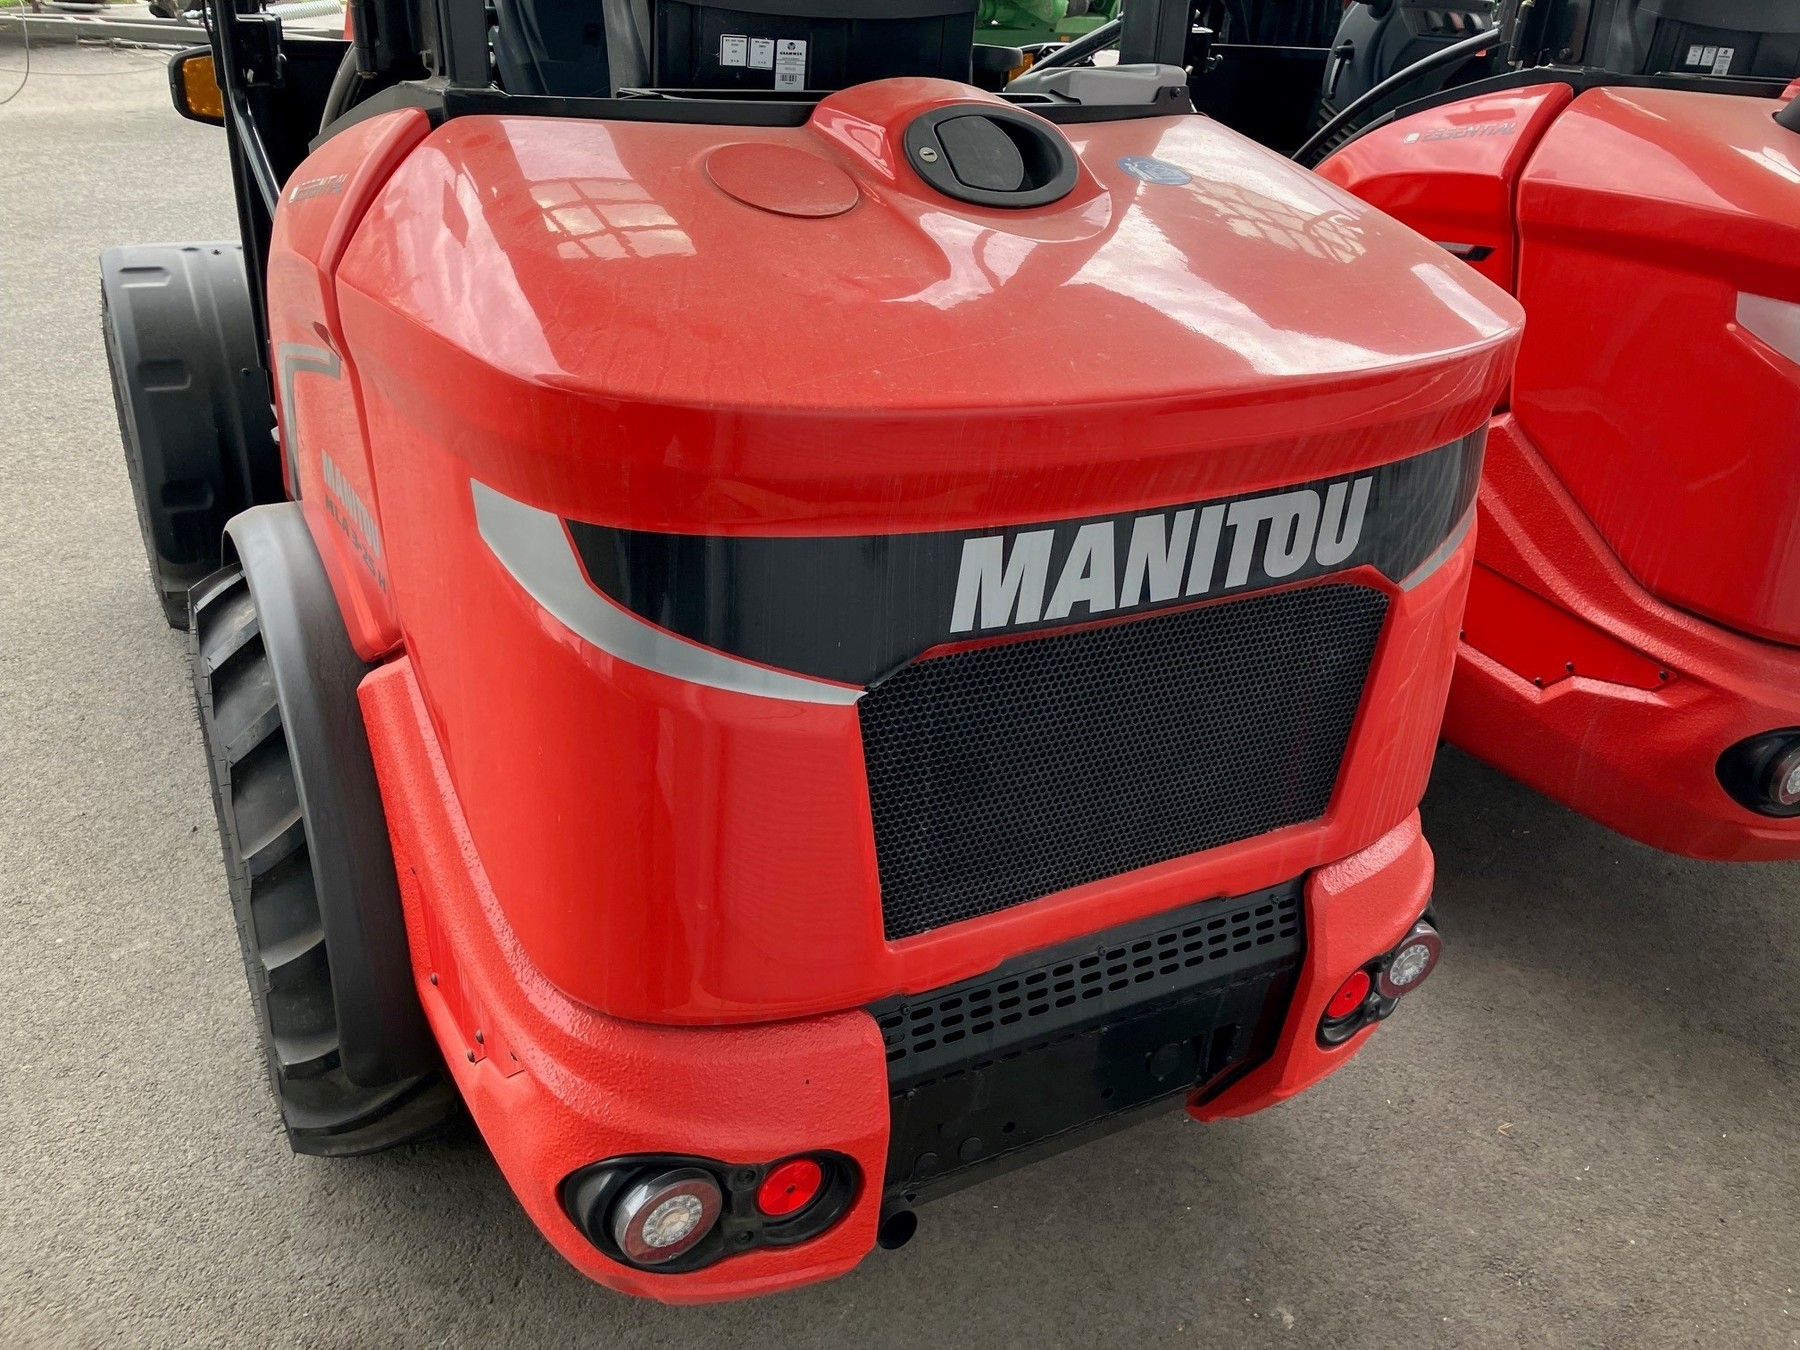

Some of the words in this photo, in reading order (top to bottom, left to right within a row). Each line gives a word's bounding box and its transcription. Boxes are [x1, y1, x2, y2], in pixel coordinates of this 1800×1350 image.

[1421, 122, 1517, 142] ESSENTIAL
[322, 448, 381, 559] MANITOU
[950, 476, 1373, 633] MANITOU
